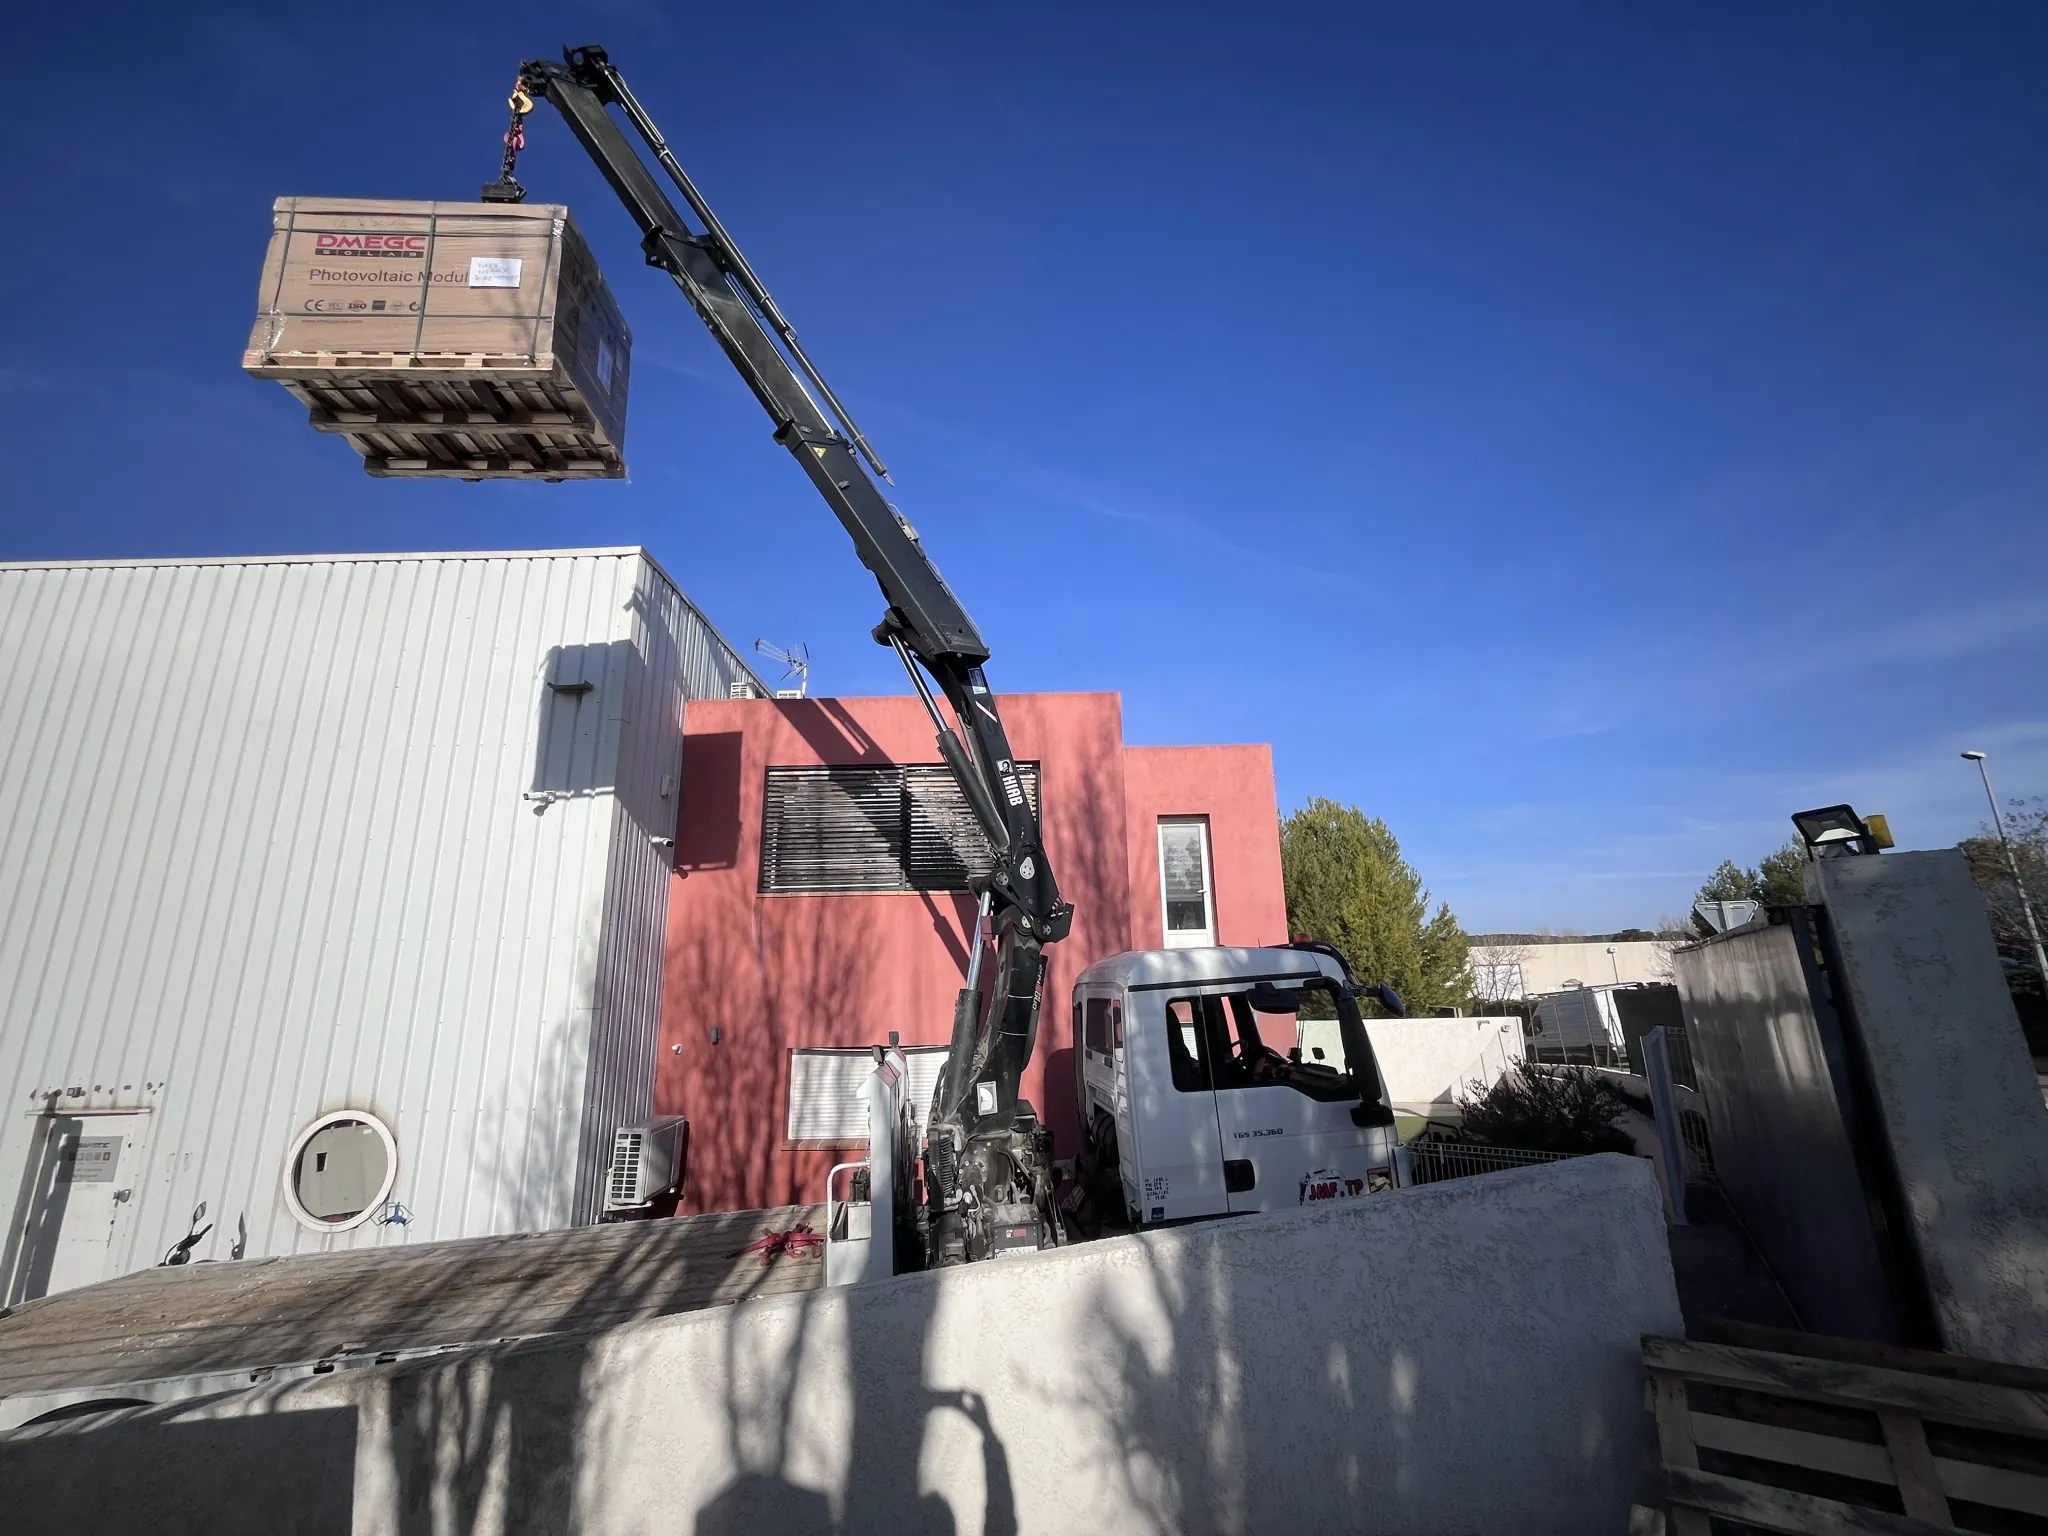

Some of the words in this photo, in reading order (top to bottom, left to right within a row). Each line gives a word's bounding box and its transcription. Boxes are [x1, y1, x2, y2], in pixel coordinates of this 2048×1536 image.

[316, 235, 426, 251] DMEGC
[319, 249, 420, 258] SOLAR
[309, 268, 413, 283] Photovoltaic
[417, 271, 469, 283] Modul
[303, 299, 325, 312] CE
[347, 302, 367, 310] ISO
[1002, 775, 1024, 807] HIAB
[1232, 1131, 1250, 1139] TGS
[1251, 1128, 1284, 1138] 35.360
